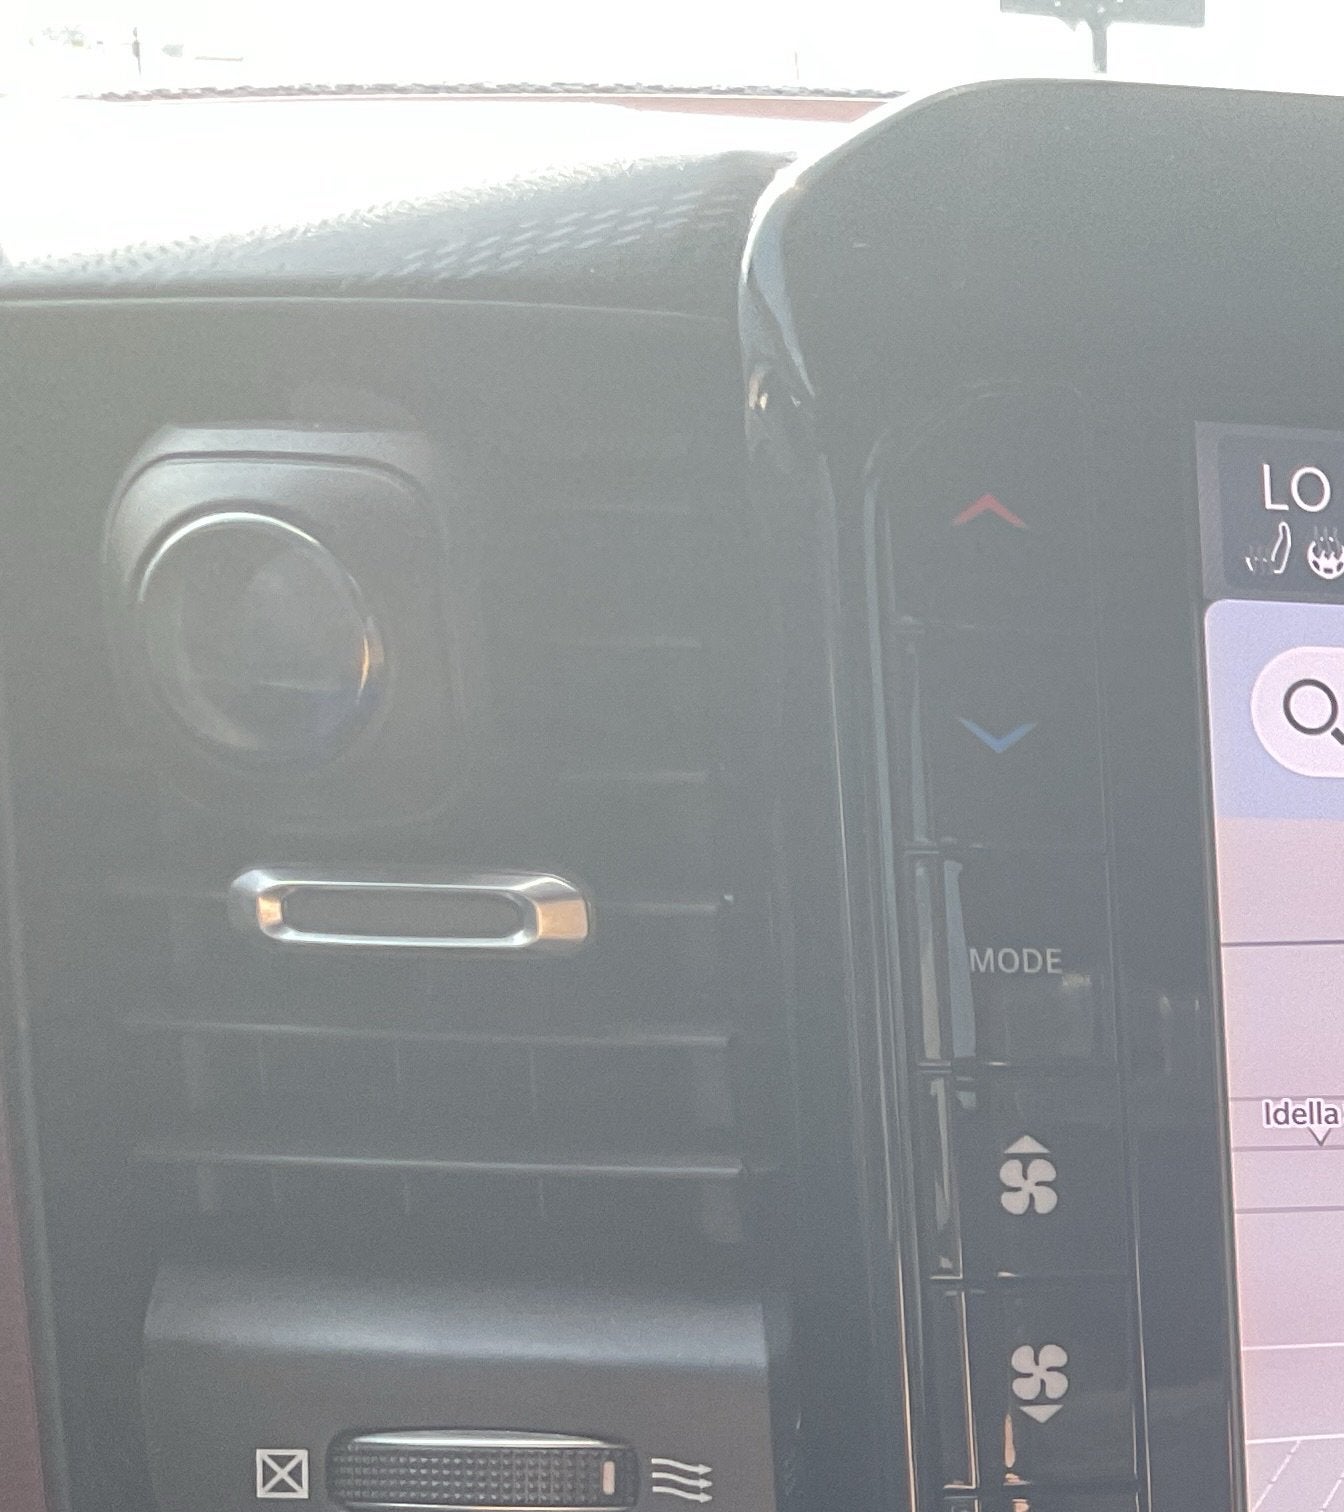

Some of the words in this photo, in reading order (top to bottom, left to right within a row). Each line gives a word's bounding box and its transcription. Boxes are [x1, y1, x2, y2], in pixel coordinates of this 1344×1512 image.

[1262, 464, 1332, 513] LO
[968, 947, 1064, 975] MODE
[1264, 1101, 1340, 1126] Idella
